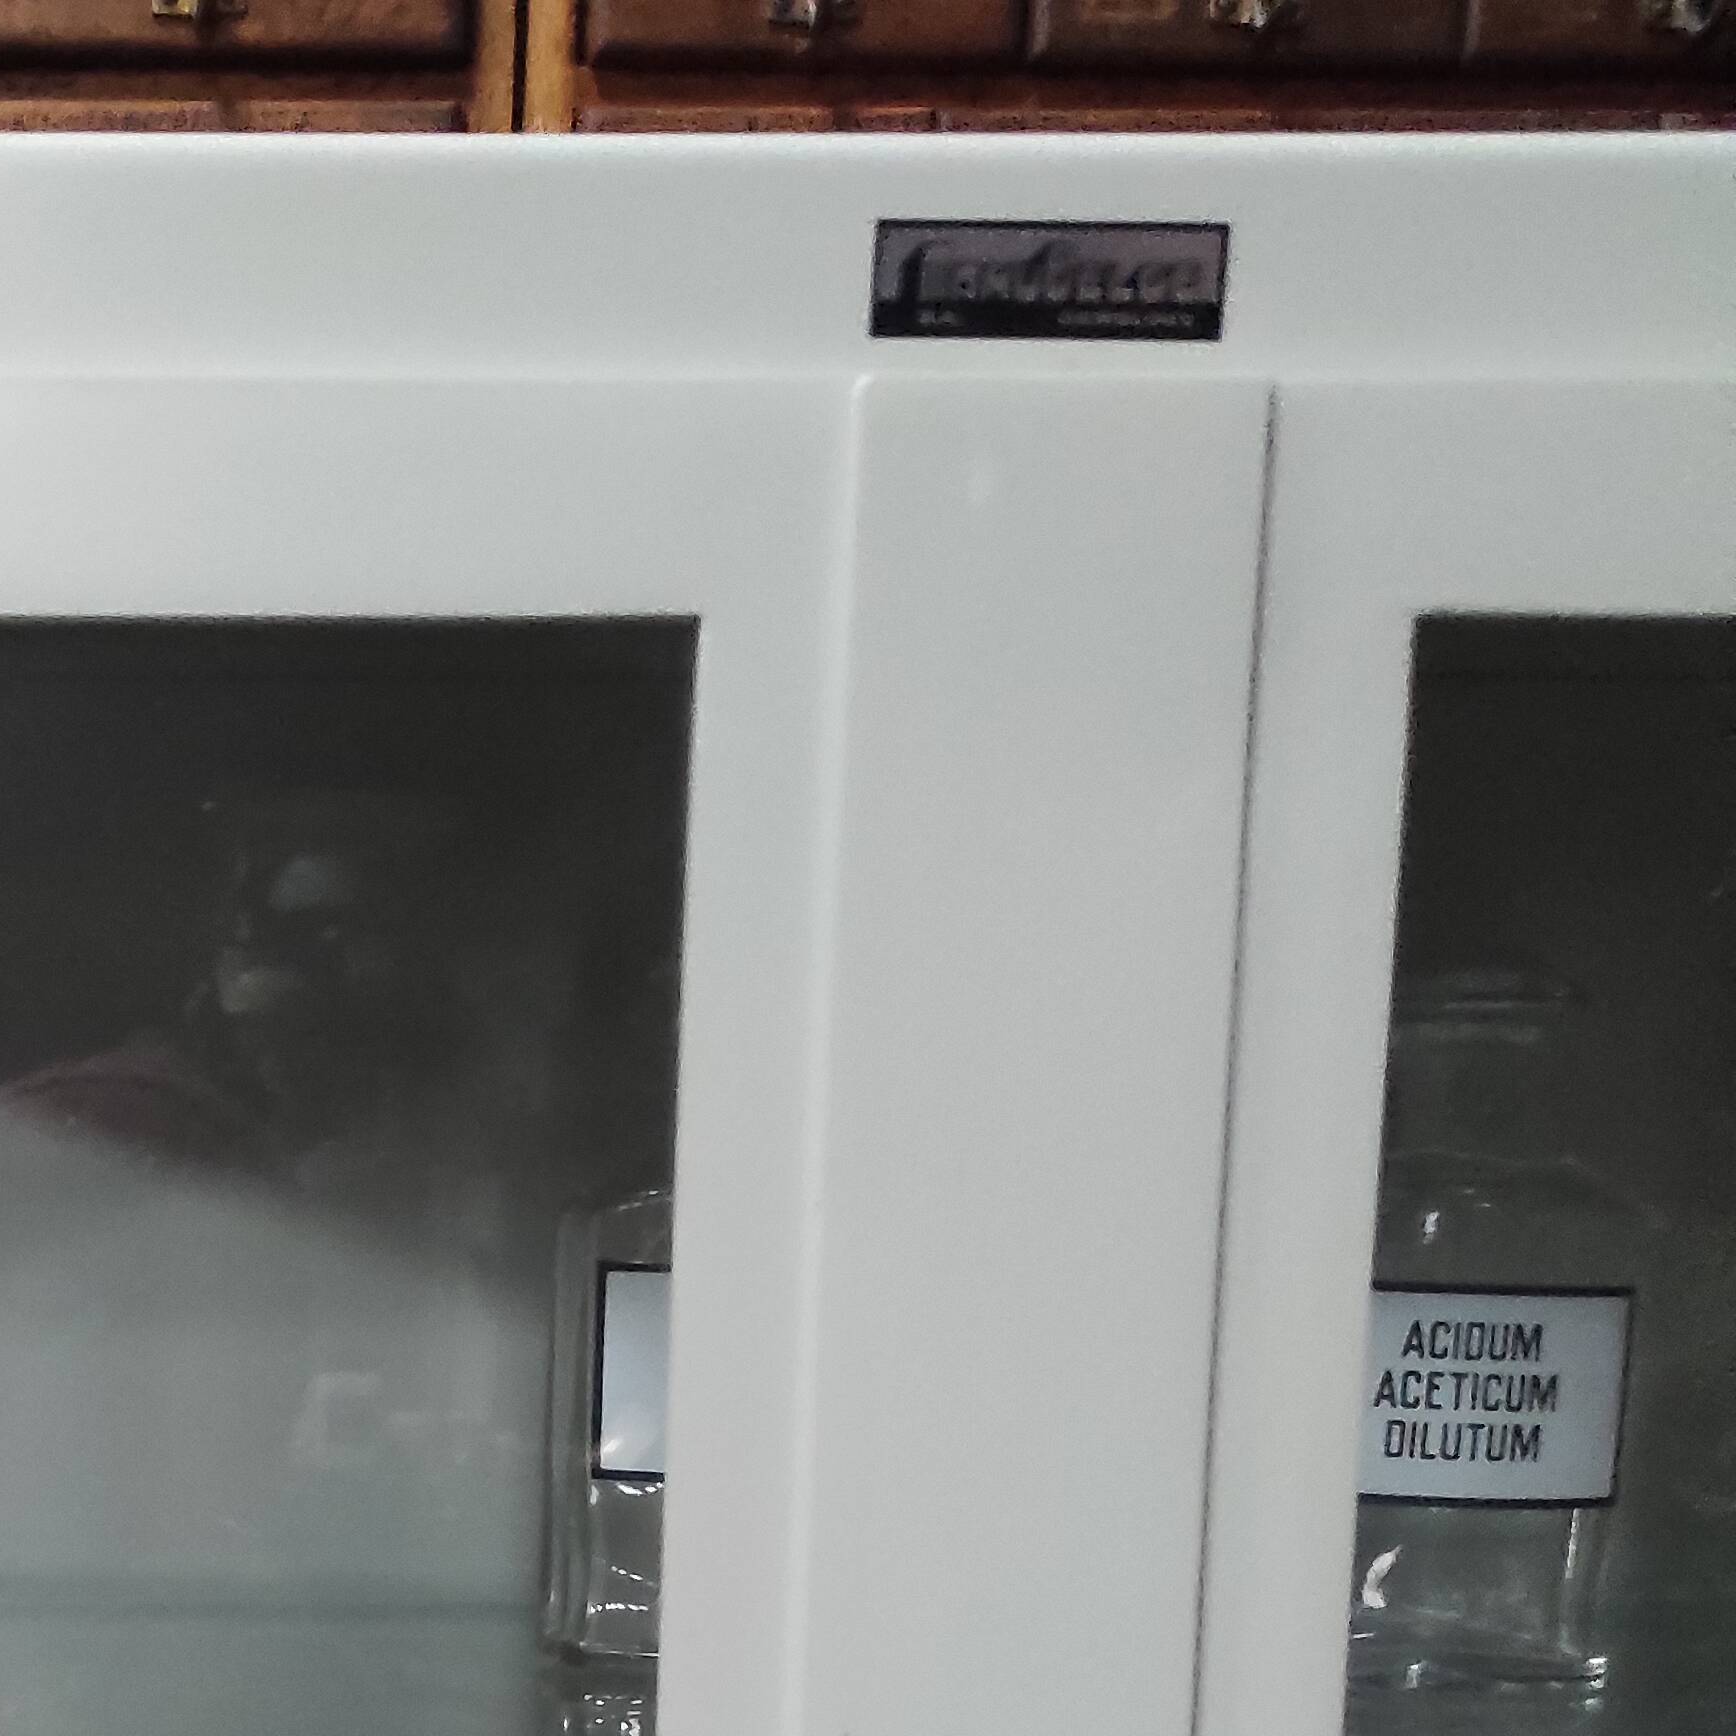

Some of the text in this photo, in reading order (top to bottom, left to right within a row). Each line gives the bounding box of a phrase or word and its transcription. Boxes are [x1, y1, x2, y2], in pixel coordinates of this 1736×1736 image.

[1401, 1319, 1543, 1361] ACIDUM
[1373, 1369, 1559, 1413] ACETICUM
[1384, 1419, 1542, 1462] DILUTUM
